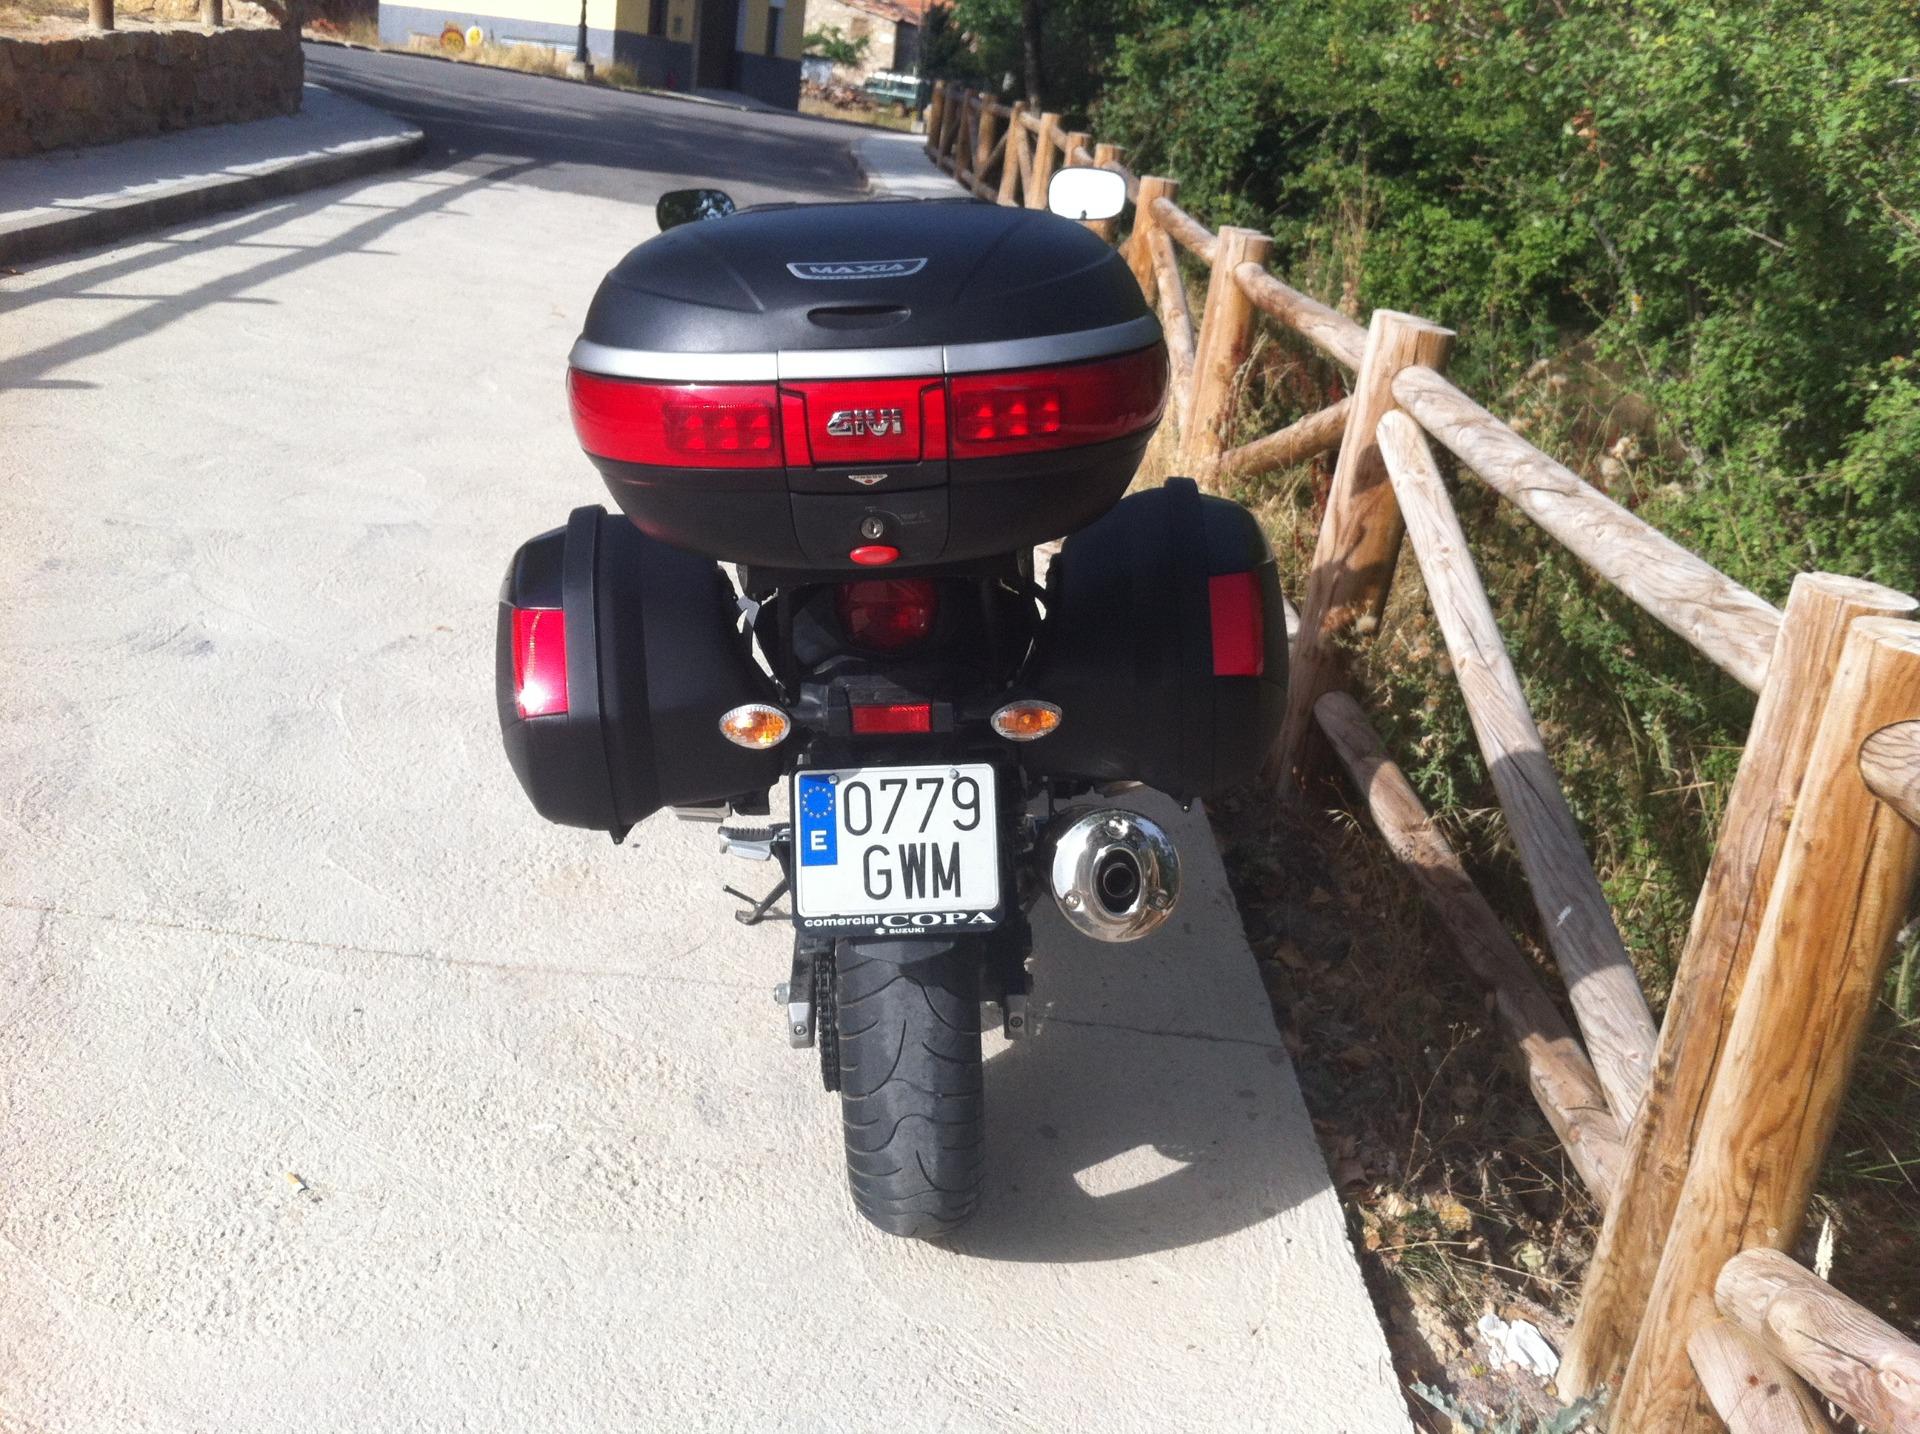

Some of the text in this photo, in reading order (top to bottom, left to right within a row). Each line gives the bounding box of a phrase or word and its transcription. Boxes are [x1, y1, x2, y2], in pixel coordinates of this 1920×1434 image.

[809, 263, 904, 274] MAXIA
[827, 409, 903, 437] GIVI
[843, 776, 981, 836] 0779
[810, 830, 828, 851] E
[862, 841, 962, 900] GWM
[804, 911, 997, 928] comercial COPA
[888, 926, 926, 935] SUZUKI
